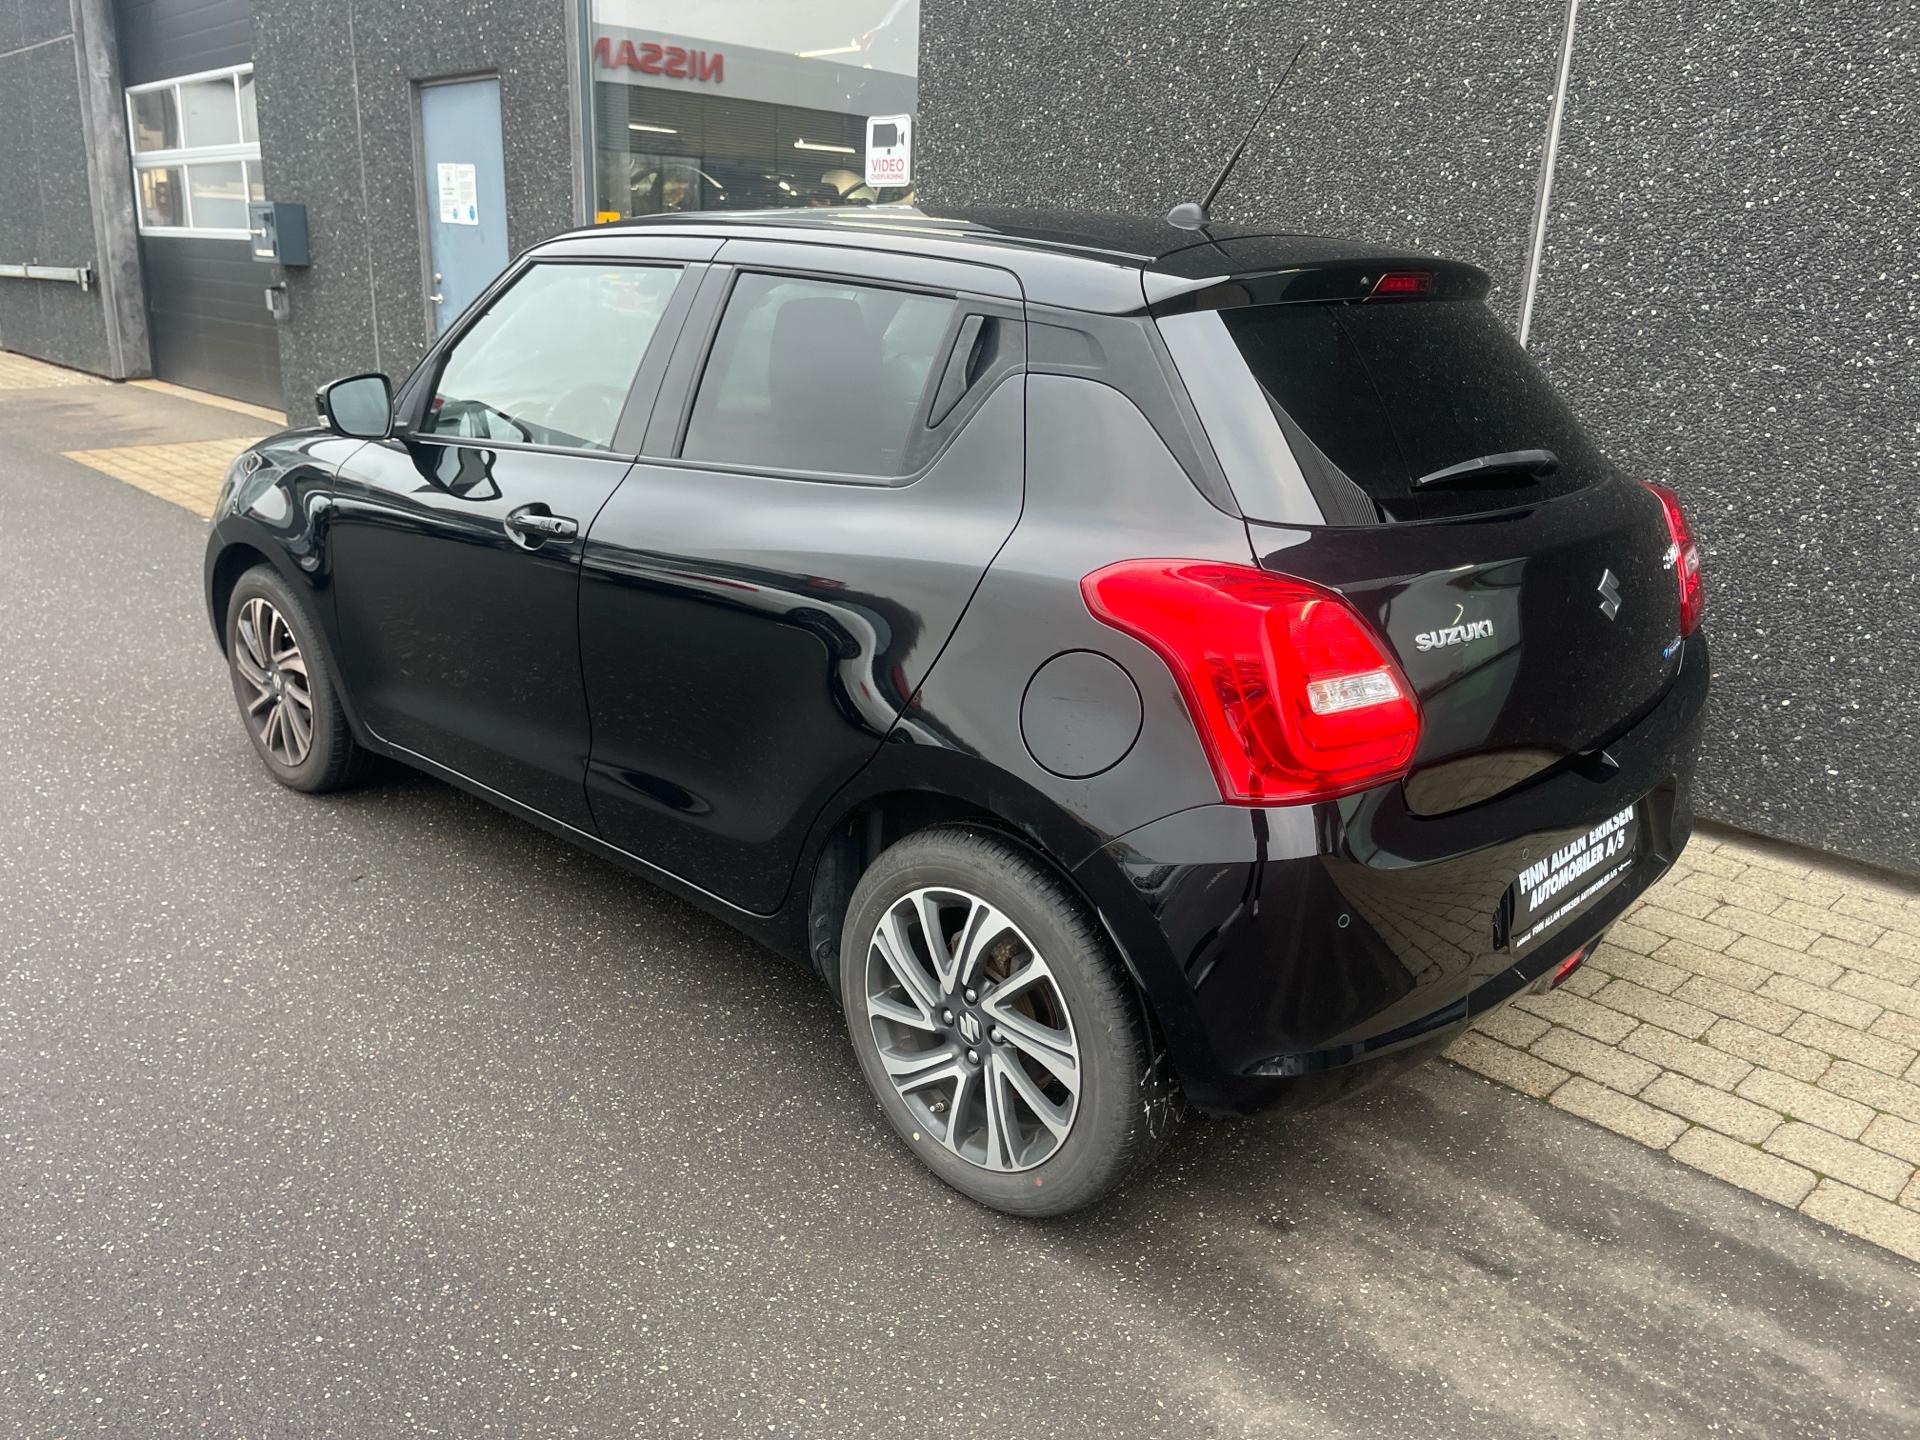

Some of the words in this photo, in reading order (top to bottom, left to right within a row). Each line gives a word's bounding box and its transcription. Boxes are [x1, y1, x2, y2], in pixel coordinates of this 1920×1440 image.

[872, 159, 904, 172] VIDEO
[1415, 619, 1494, 652] SUZUKI
[1518, 858, 1549, 895] FINN
[1551, 835, 1586, 873] ALLAN
[1589, 805, 1634, 846] ERIKSEN
[1529, 843, 1604, 912] AUTOMOBILER
[1606, 828, 1625, 857] A/S
